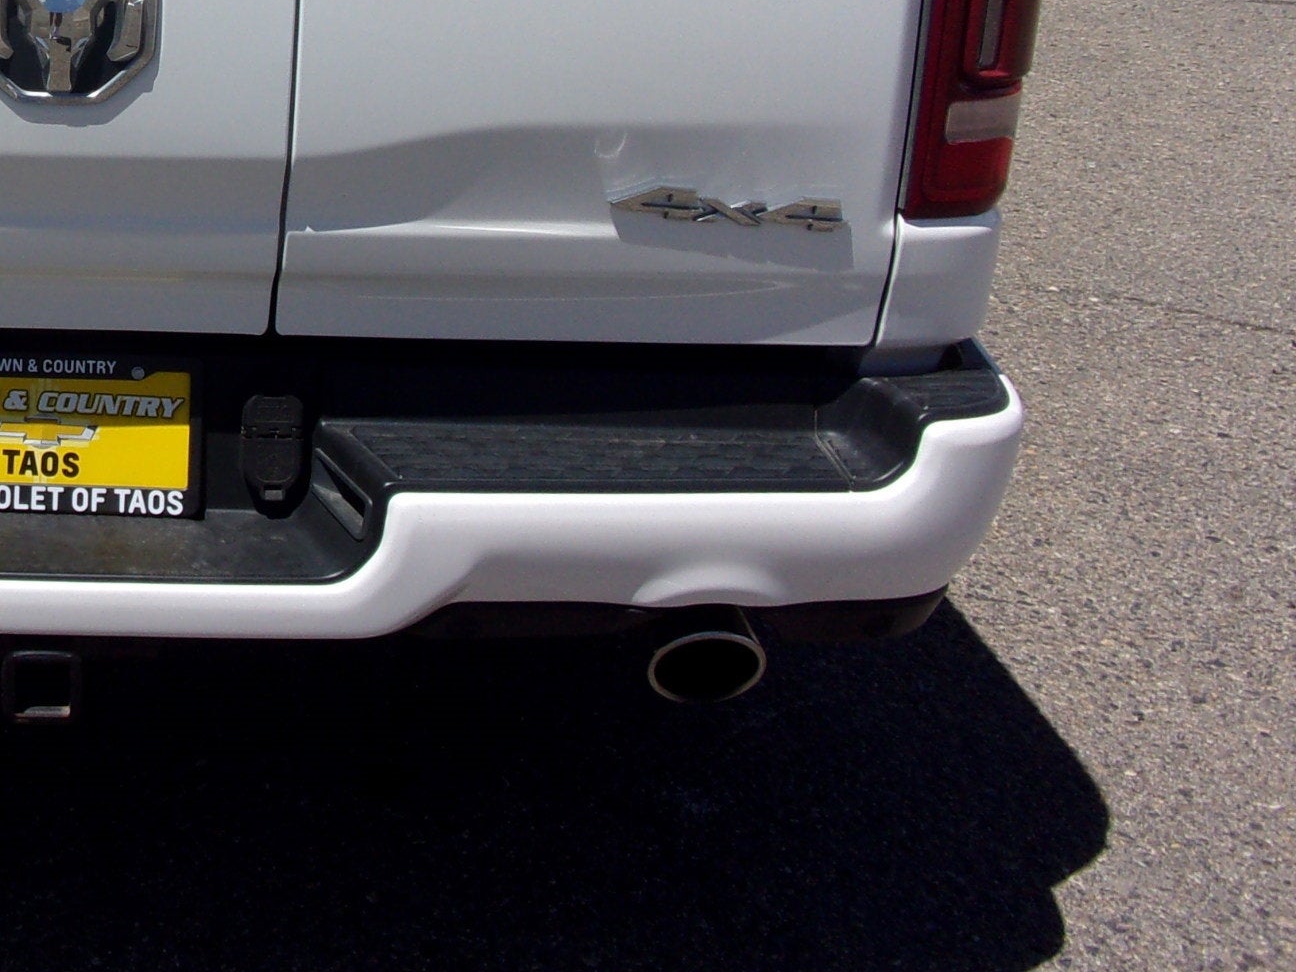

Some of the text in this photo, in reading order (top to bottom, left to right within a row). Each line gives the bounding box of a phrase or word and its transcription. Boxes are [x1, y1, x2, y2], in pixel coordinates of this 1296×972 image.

[27, 359, 38, 373] &
[42, 359, 117, 375] COUNTRY
[3, 390, 29, 411] &
[37, 391, 184, 419] COUNTRY
[2, 449, 80, 478] TAOS
[71, 487, 106, 513] OF
[114, 488, 184, 516] TAOS
